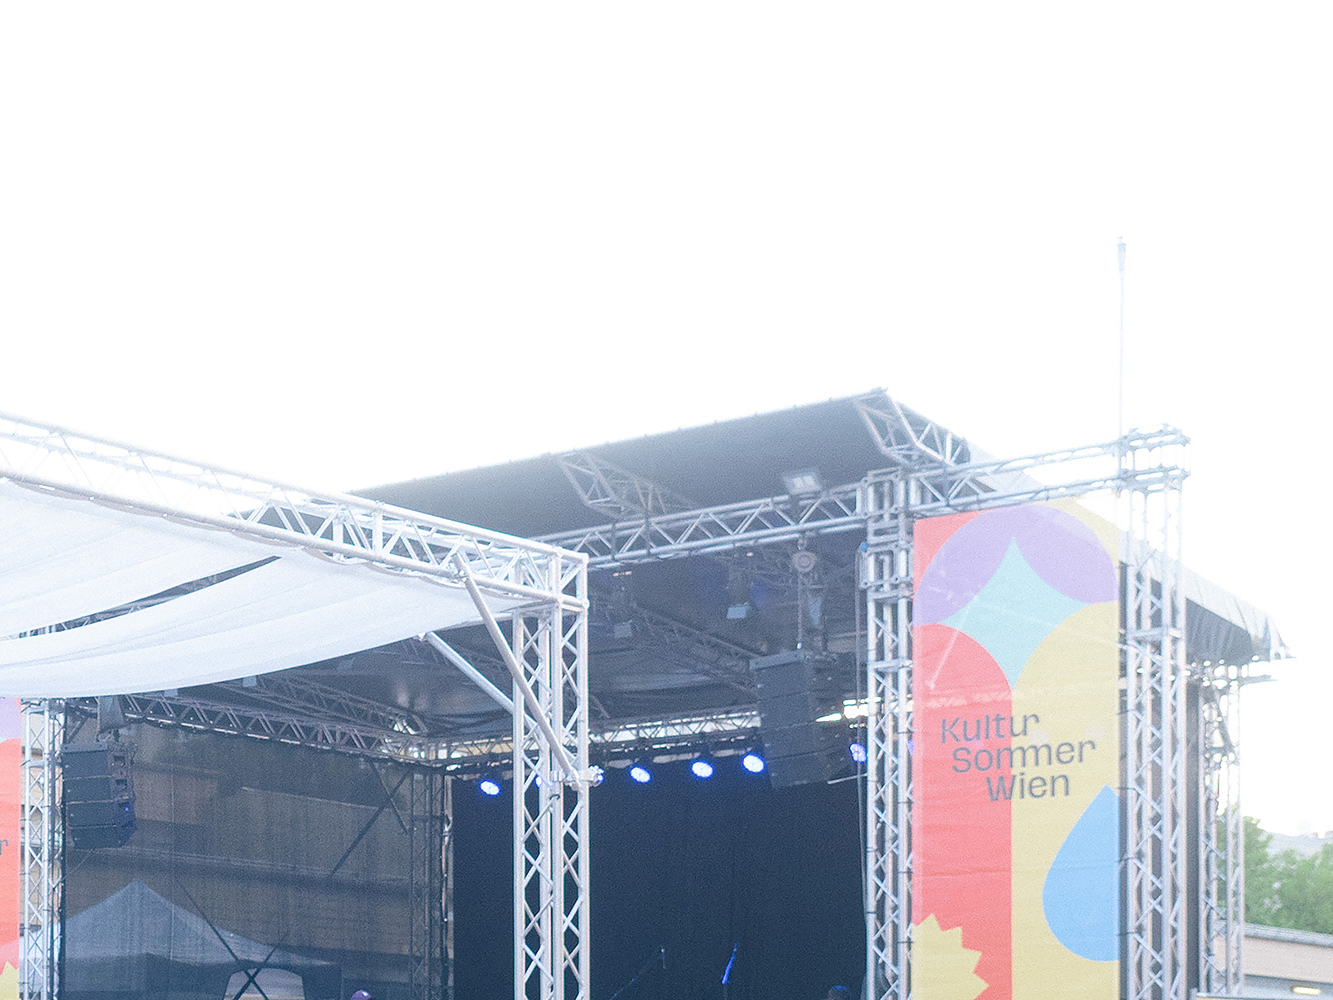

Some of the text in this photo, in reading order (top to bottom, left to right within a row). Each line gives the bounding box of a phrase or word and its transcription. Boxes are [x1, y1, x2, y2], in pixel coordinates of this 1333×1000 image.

[940, 713, 1040, 744] Kultur
[952, 740, 1096, 773] Sommer
[986, 772, 1070, 802] Wien
